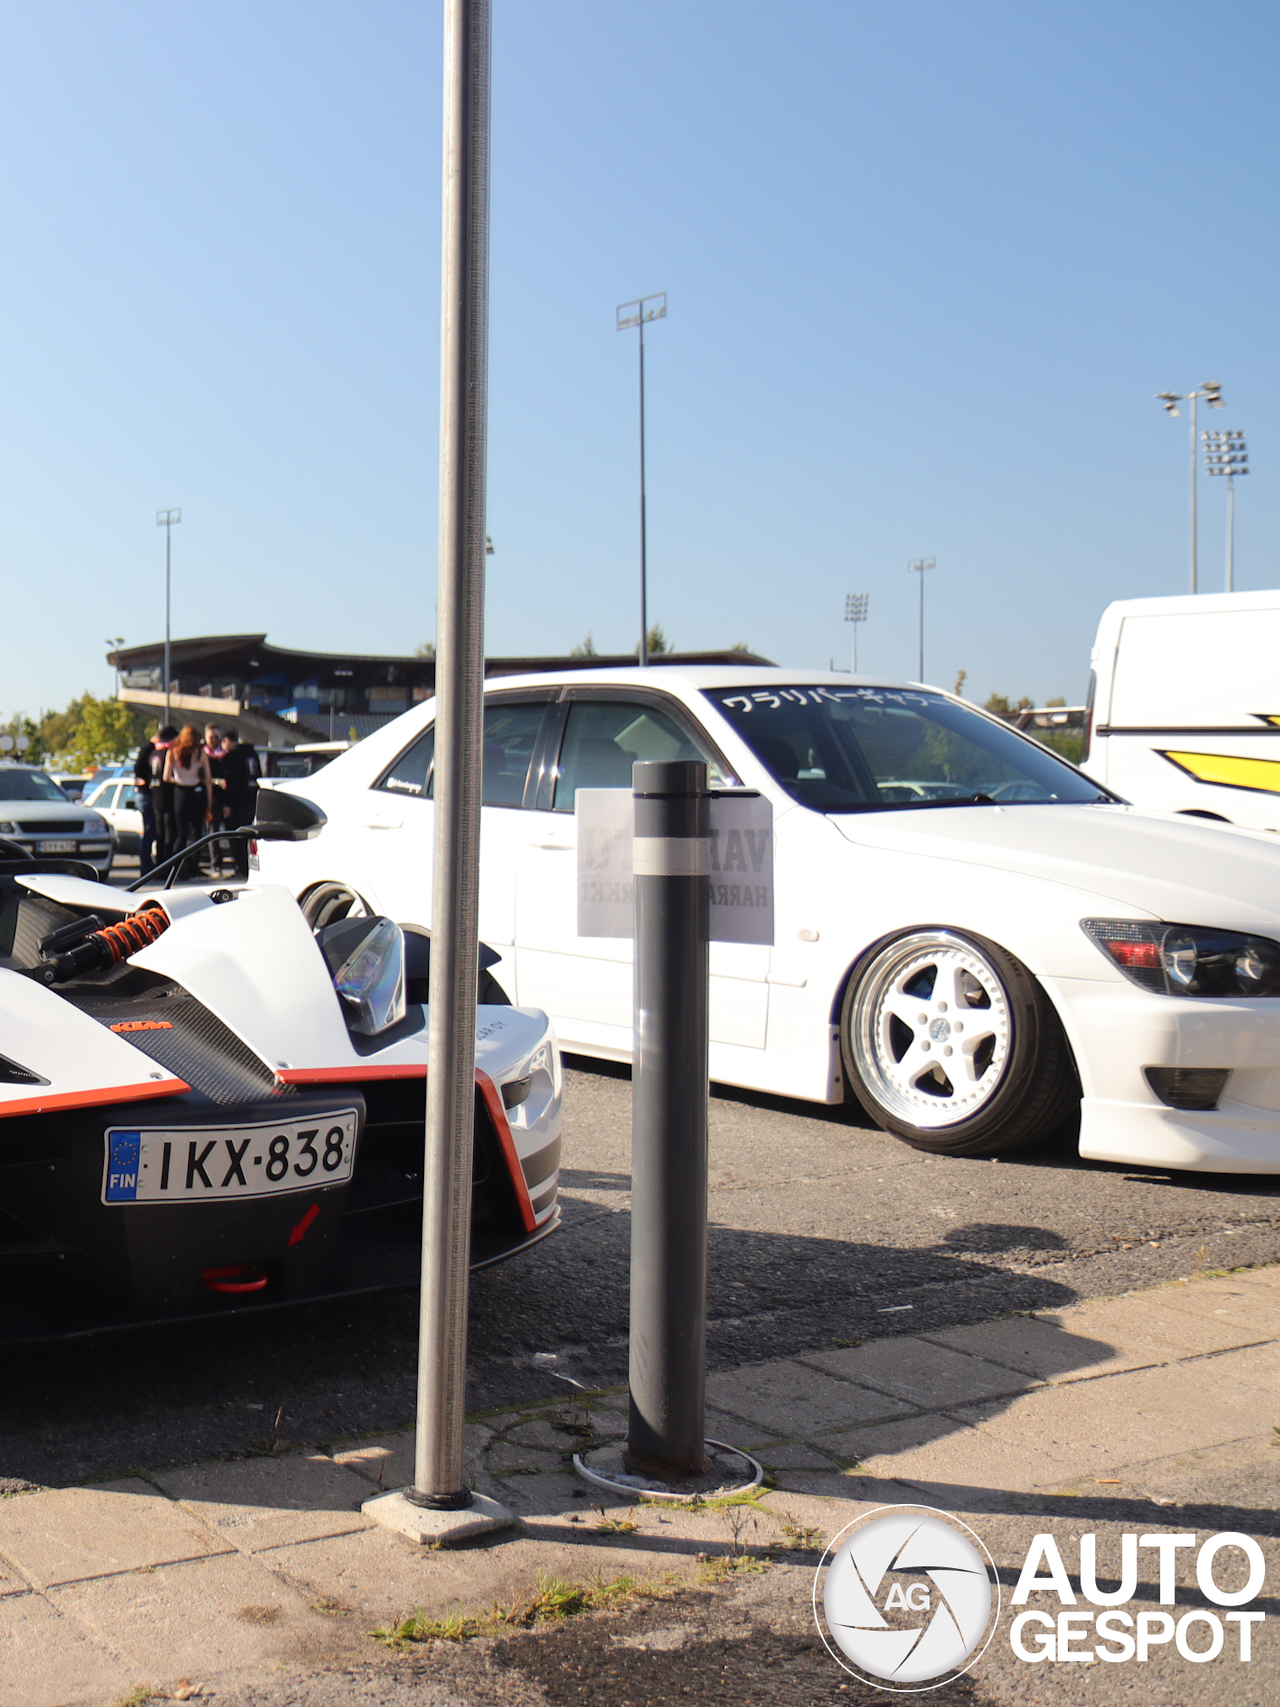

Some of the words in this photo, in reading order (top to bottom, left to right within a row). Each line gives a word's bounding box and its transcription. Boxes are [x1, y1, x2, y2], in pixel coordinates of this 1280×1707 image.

[109, 1020, 174, 1033] KTM
[159, 1126, 344, 1190] IKX-838
[110, 1173, 136, 1189] FIN
